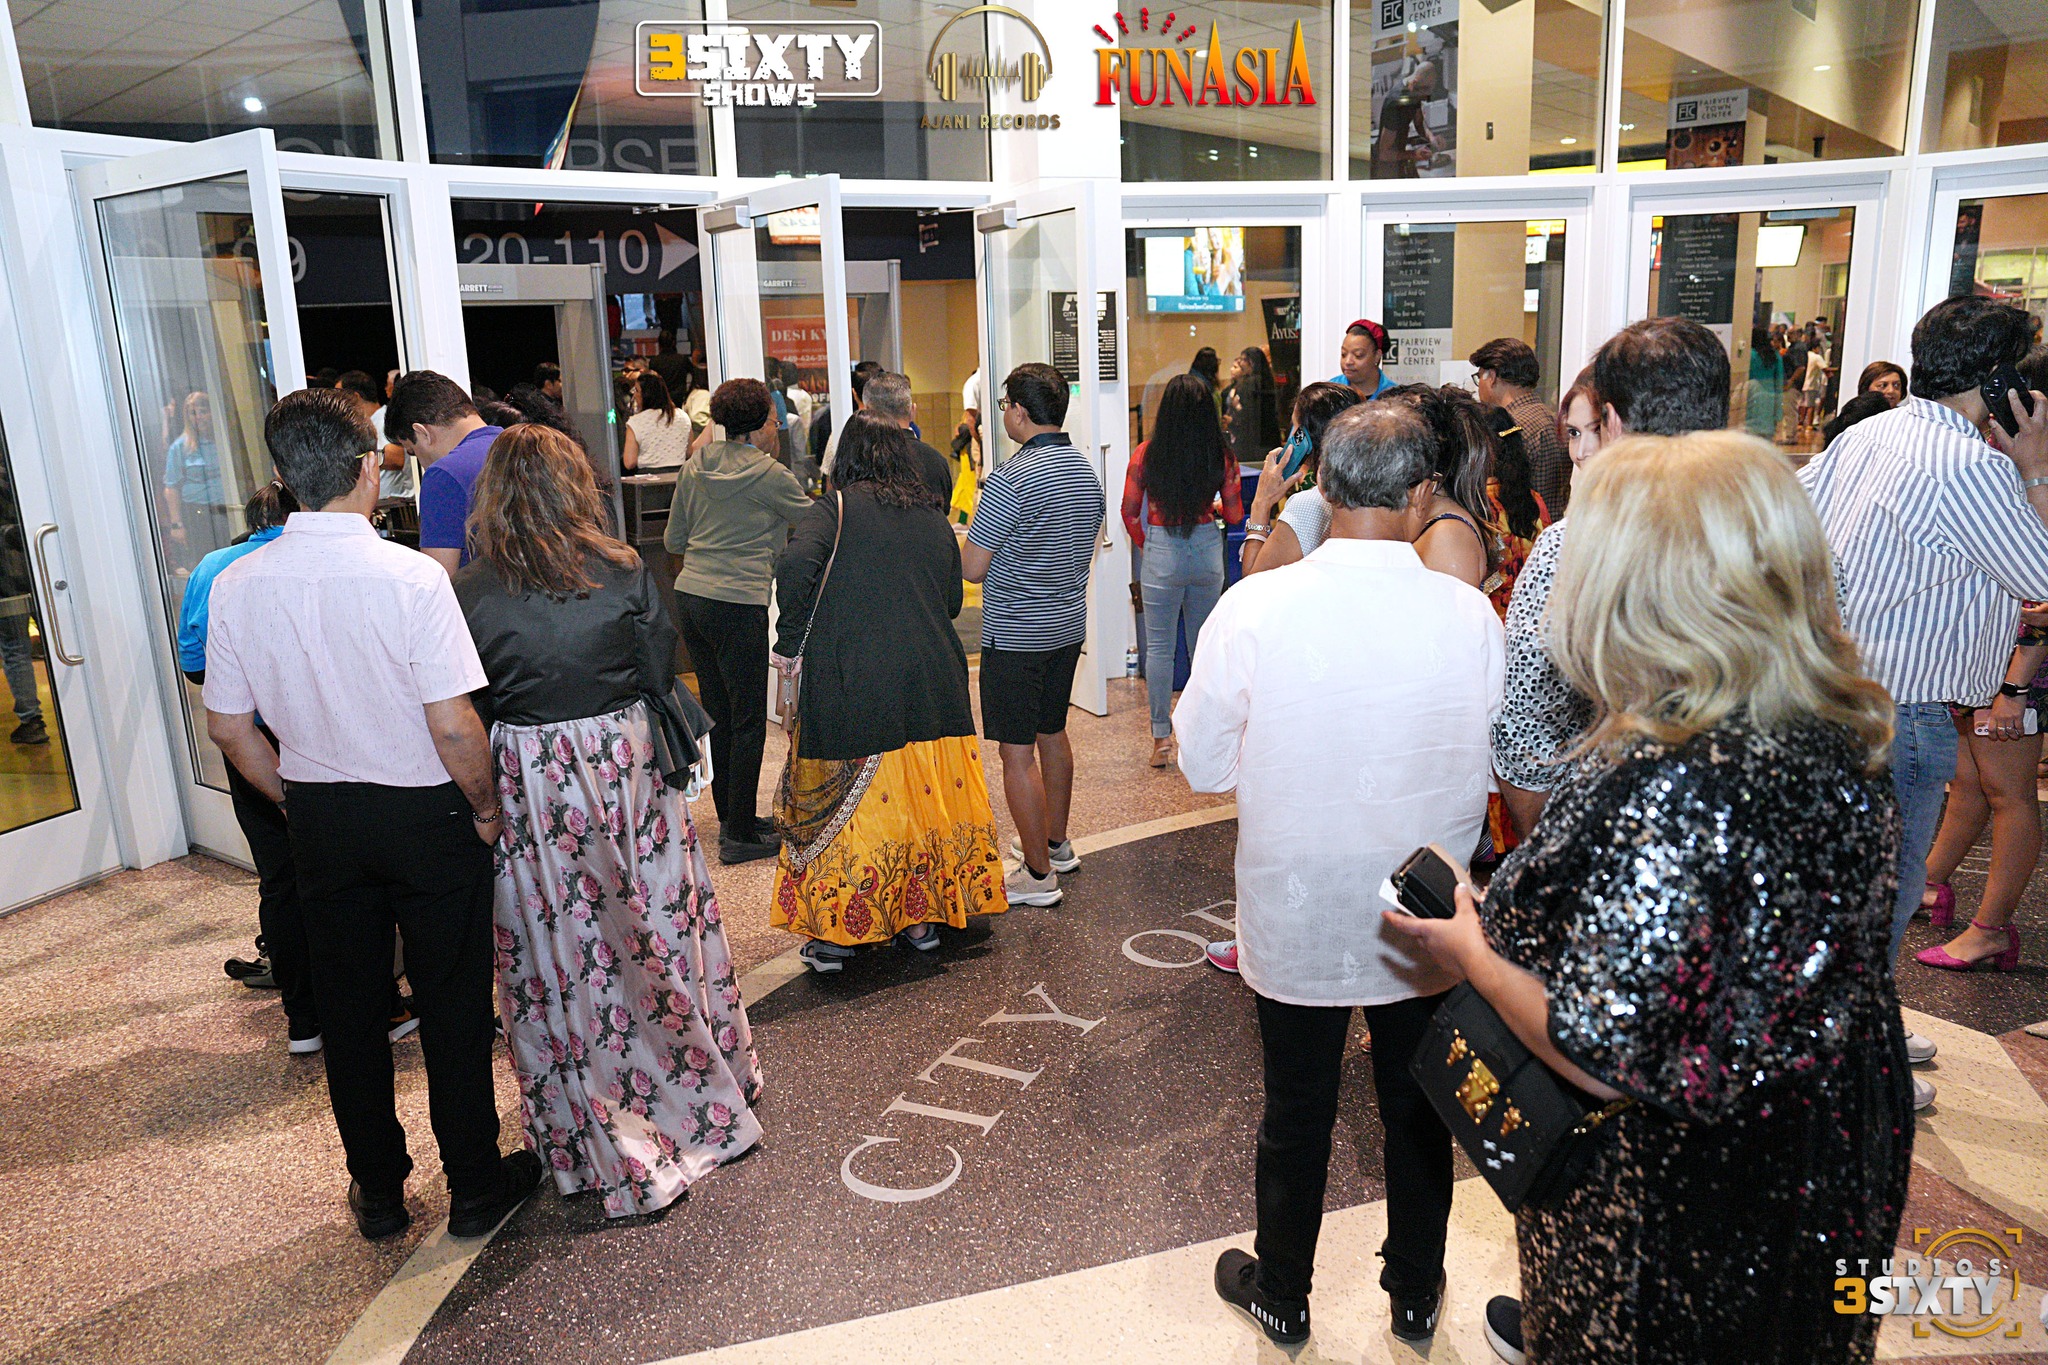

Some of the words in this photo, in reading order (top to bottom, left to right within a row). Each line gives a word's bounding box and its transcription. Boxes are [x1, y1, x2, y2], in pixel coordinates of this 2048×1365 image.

[1409, 7, 1442, 22] CENTER
[1699, 97, 1738, 107] FAIRVIEW
[1705, 104, 1731, 112] TOWN
[1701, 111, 1732, 120] CENTER
[460, 284, 488, 292] ARRETT
[771, 329, 807, 342] DESI
[1401, 338, 1442, 346] FAIRVIEW
[1407, 347, 1435, 356] TOWN
[1403, 357, 1436, 366] CENTER
[840, 981, 1107, 1202] CITY
[1250, 1301, 1288, 1334] NOBULL
